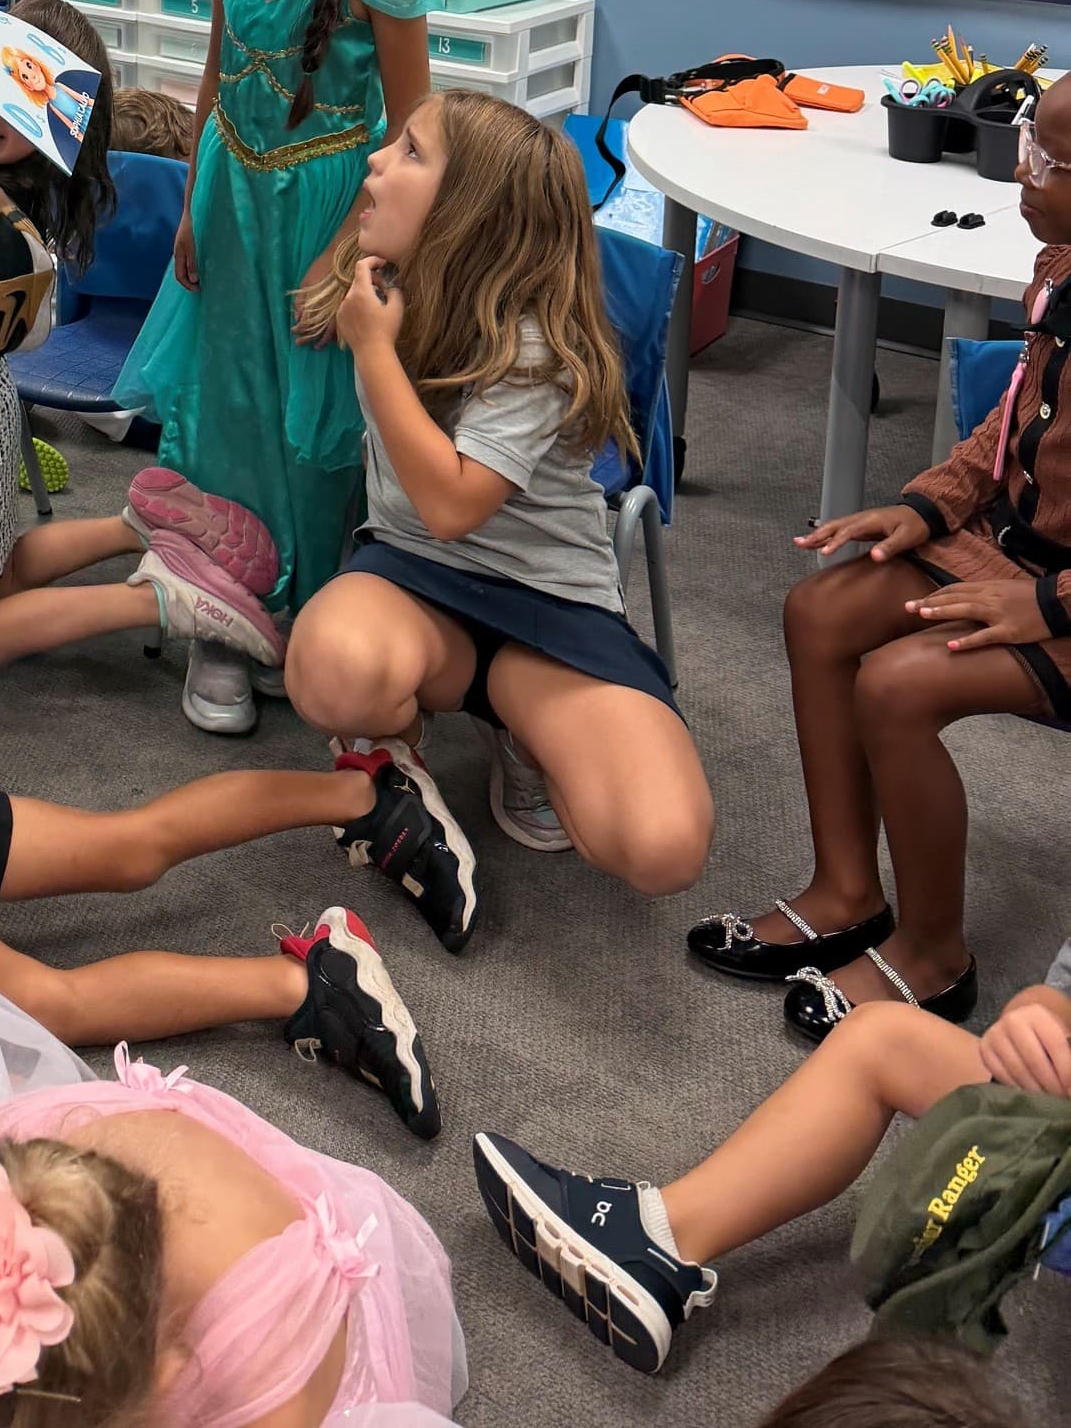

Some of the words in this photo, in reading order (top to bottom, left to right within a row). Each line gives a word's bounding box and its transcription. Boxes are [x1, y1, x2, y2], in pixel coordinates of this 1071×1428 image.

[192, 0, 199, 14] 5
[438, 36, 450, 54] 13
[196, 596, 234, 628] HOKA
[928, 1144, 986, 1222] Ranger
